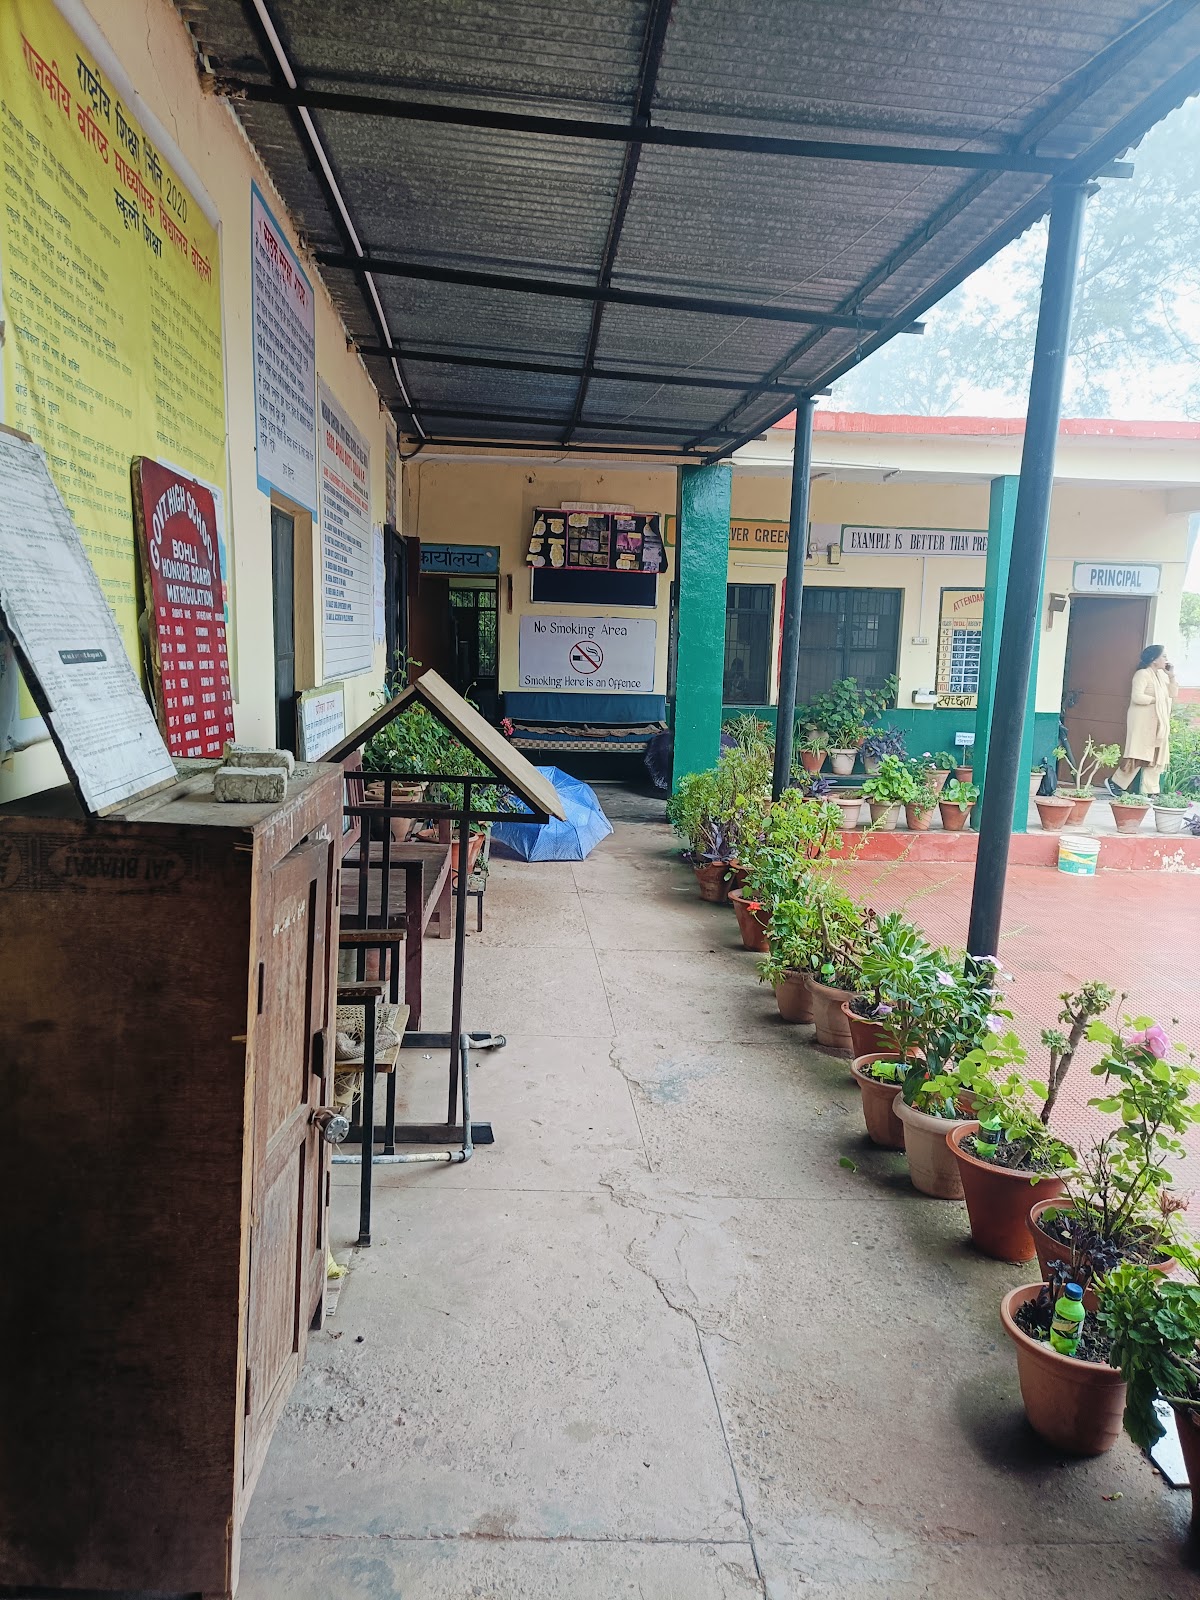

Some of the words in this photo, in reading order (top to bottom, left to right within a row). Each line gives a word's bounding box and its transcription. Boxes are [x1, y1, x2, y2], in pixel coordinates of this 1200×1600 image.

[20, 32, 72, 120] राजकीय
[77, 103, 109, 164] वरिष्ठ
[114, 149, 155, 217] माध्यमिक
[159, 199, 188, 258] विद्यालय
[76, 53, 110, 124] राष्ट्रीय
[115, 101, 140, 164] शिक्षा
[166, 177, 188, 223] 2020
[113, 188, 140, 232] स्कूली
[142, 217, 163, 259] शिक्षा
[56, 250, 70, 267] 10+2
[15, 381, 28, 398] बोर्ड
[168, 483, 186, 513] HIGH
[187, 491, 216, 579] SCHOOL
[851, 531, 891, 550] EXAMPLE
[894, 531, 903, 550] IS
[910, 533, 945, 551] BETTER
[950, 535, 969, 551] THAN
[172, 539, 198, 565] BOHLI
[421, 547, 484, 567] कार्यालय
[161, 557, 191, 582] HONOUR
[191, 565, 212, 587] BOARD
[1090, 568, 1142, 587] PRINCIPAL
[534, 621, 547, 634] No
[550, 622, 595, 638] Smoking
[601, 622, 628, 636] Area
[524, 675, 563, 689] Smoking
[564, 676, 585, 688] Here
[587, 676, 594, 688] is
[595, 679, 607, 688] an
[608, 678, 641, 689] Offence
[937, 695, 974, 707] स्वच्छता
[145, 856, 176, 881] JAI
